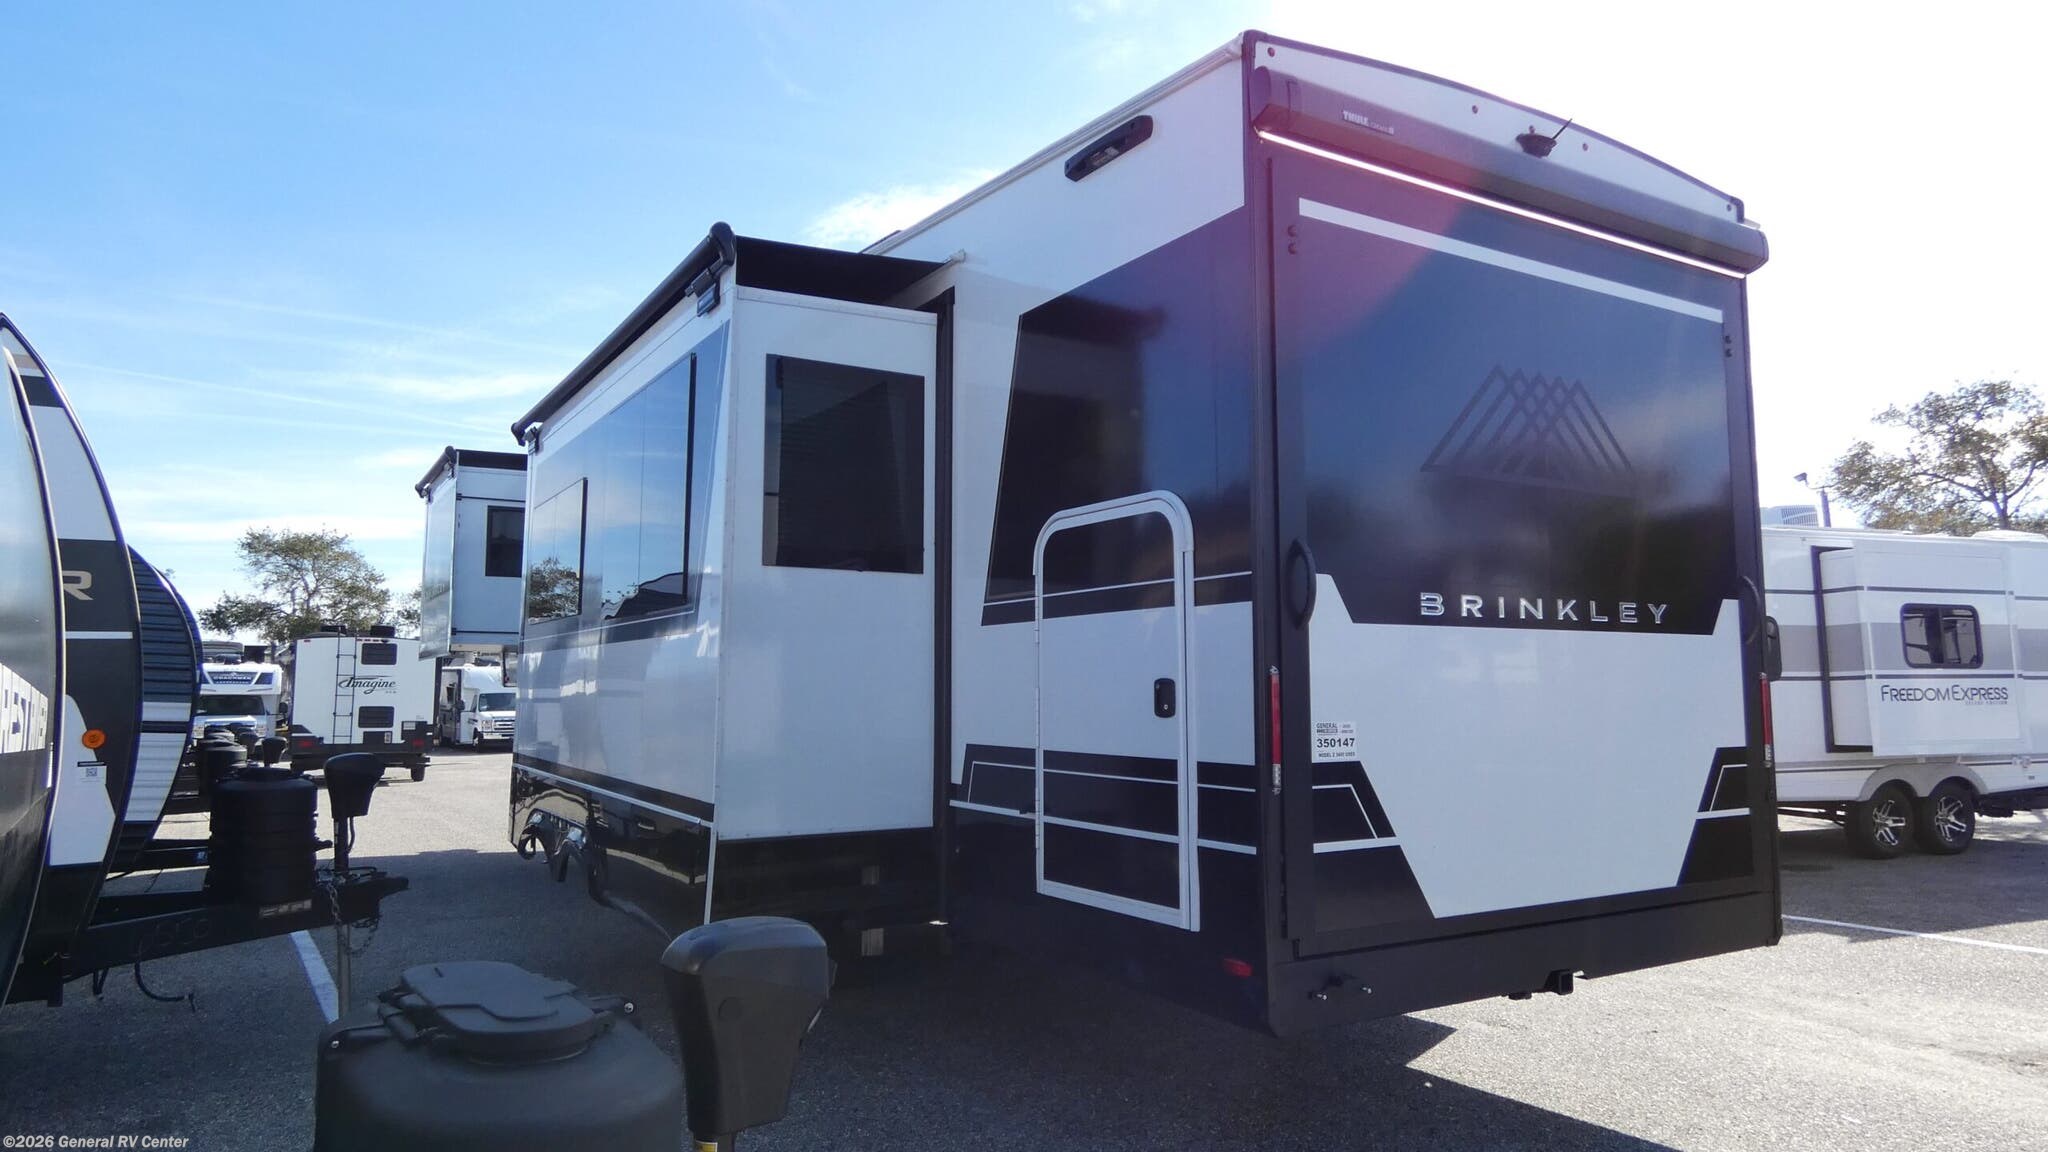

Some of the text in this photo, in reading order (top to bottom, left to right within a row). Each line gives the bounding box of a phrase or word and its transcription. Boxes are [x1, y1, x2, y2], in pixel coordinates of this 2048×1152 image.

[1420, 592, 1667, 624] BRINKLEY
[338, 677, 396, 695] Imagine
[1880, 684, 2008, 702] FREEDOM EXPRESS
[1316, 737, 1355, 748] 350147
